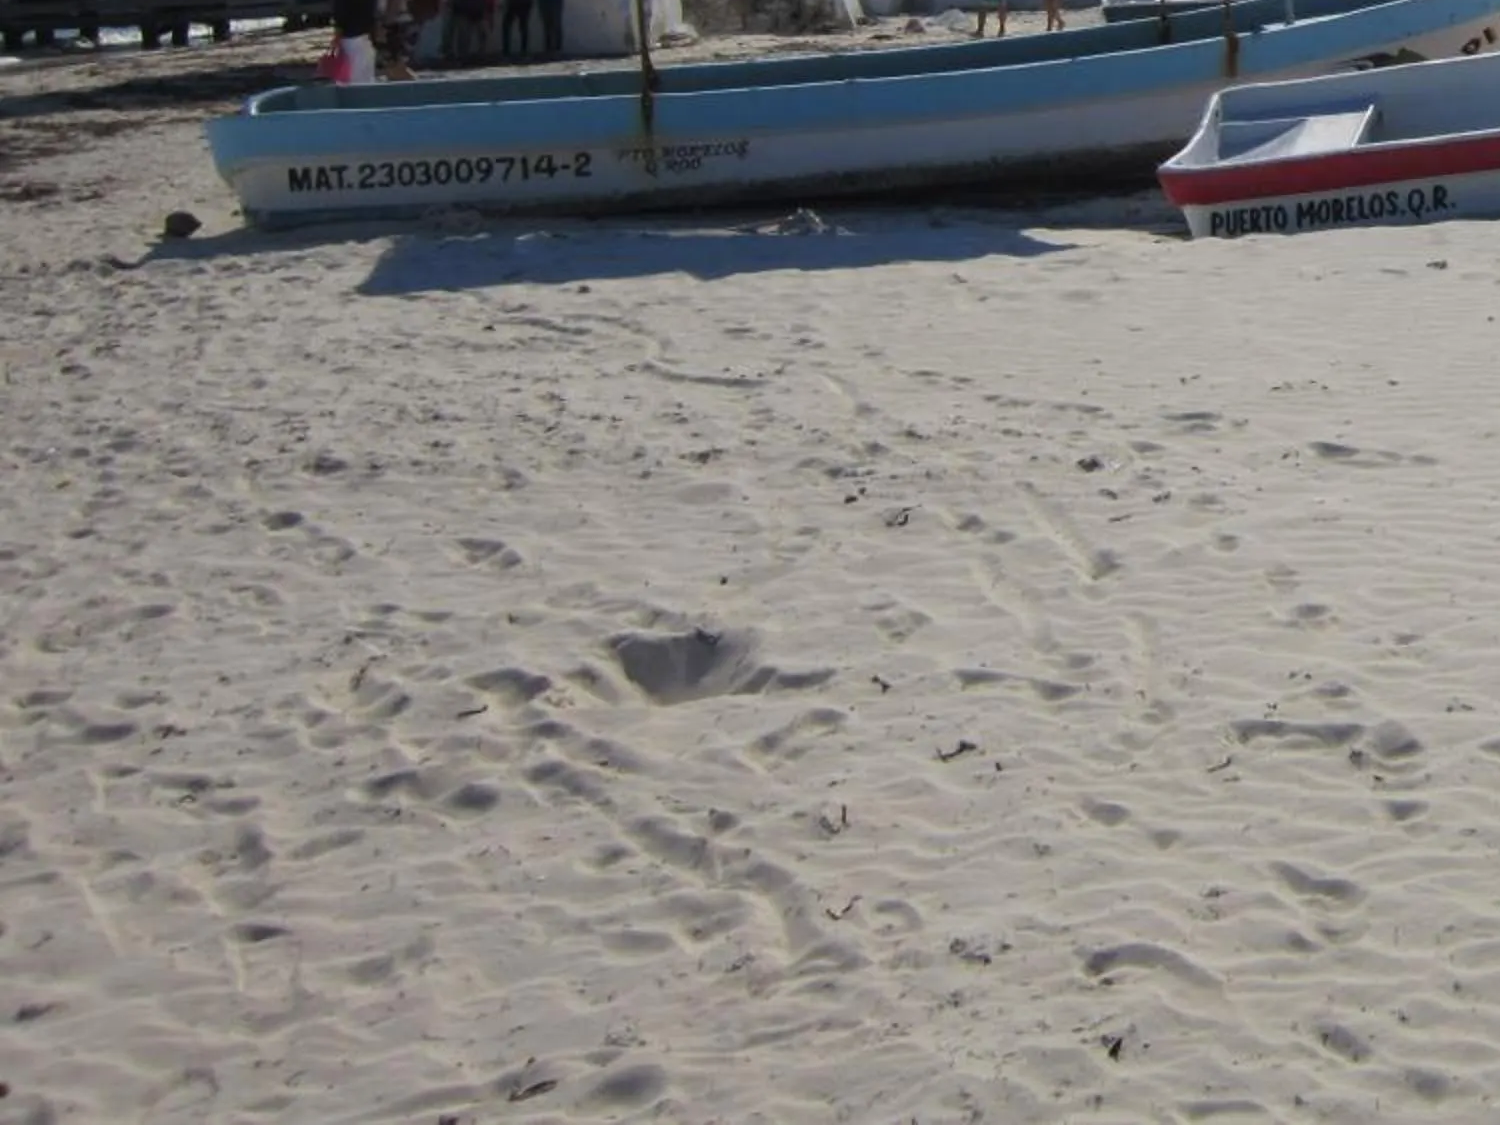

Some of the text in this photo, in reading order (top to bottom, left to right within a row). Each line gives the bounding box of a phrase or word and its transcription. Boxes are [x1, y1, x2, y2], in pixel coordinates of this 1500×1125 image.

[288, 152, 593, 194] MAT. 2303009714-2
[1210, 205, 1288, 236] PUERTO
